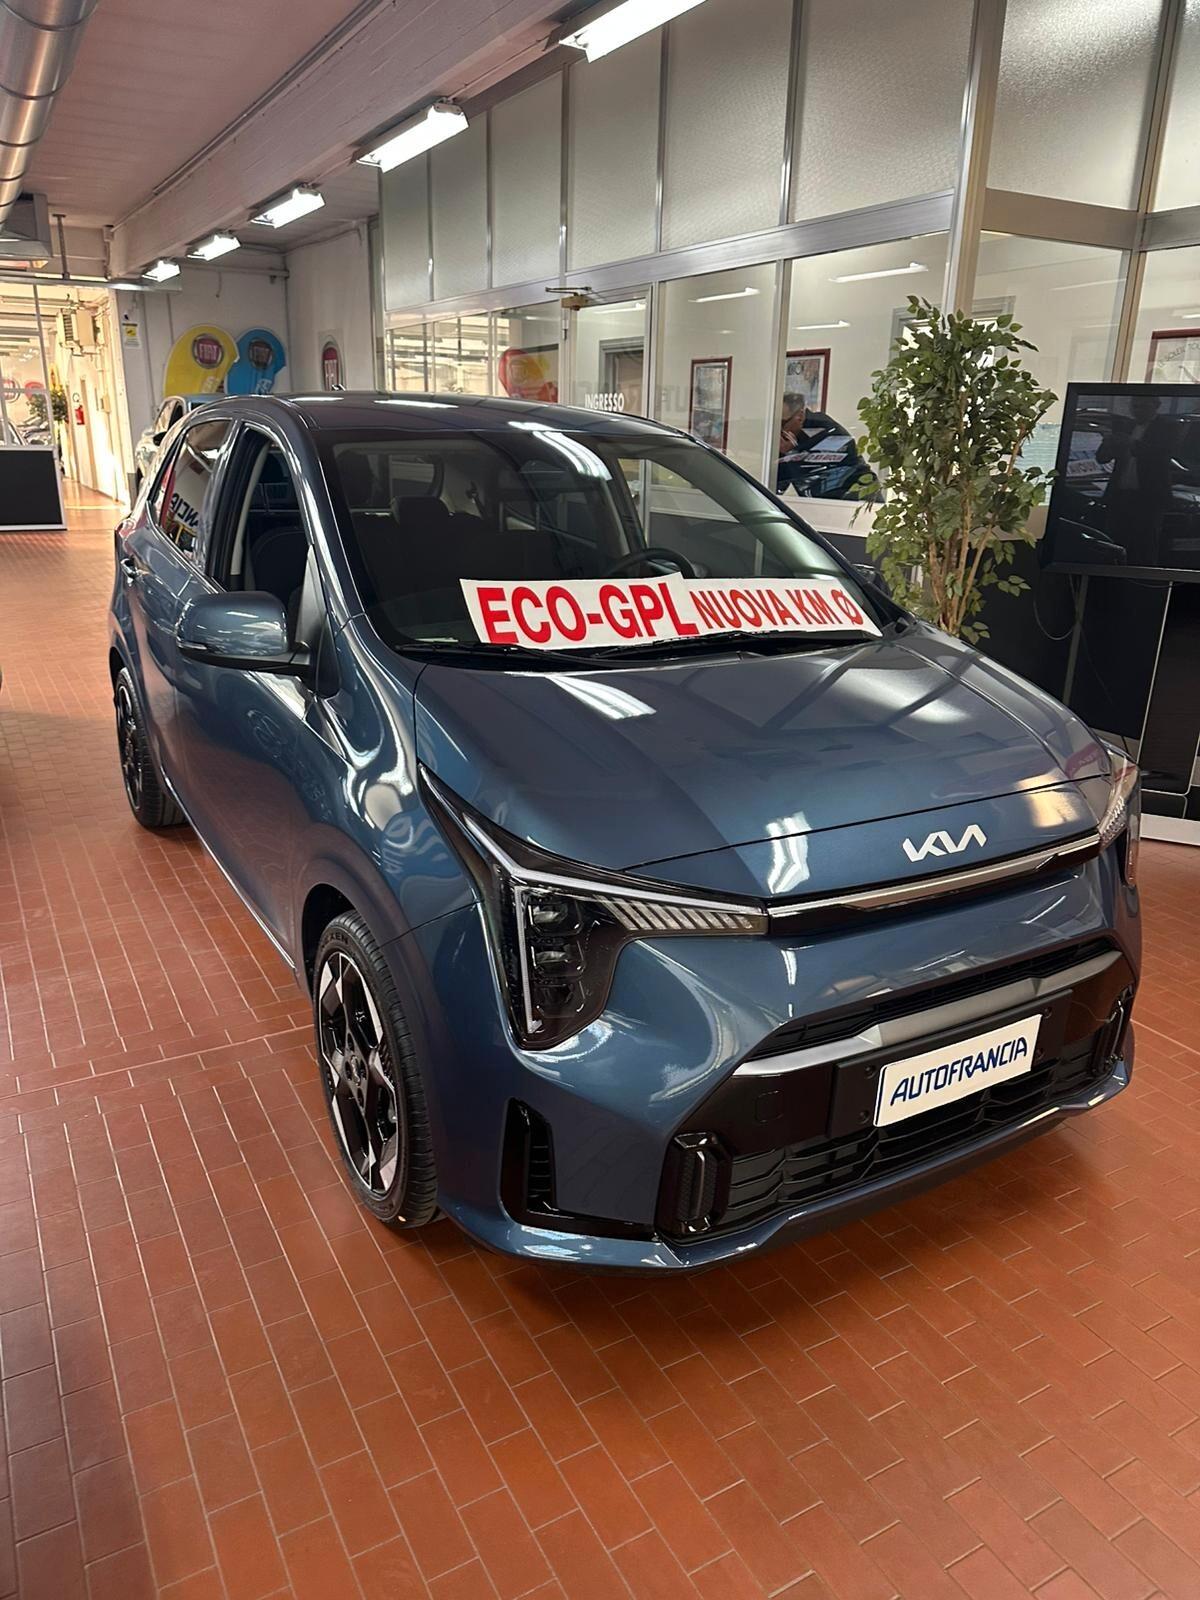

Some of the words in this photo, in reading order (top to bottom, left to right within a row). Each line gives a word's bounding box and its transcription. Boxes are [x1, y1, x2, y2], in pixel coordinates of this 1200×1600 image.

[199, 344, 218, 360] FIAT
[585, 392, 625, 412] INGRESSO
[477, 582, 699, 645] ECO-GPL
[691, 588, 795, 627] NUOVA
[792, 588, 843, 625] KM
[902, 824, 988, 863] KIA
[889, 1036, 1028, 1107] AUTOFRANCIA
